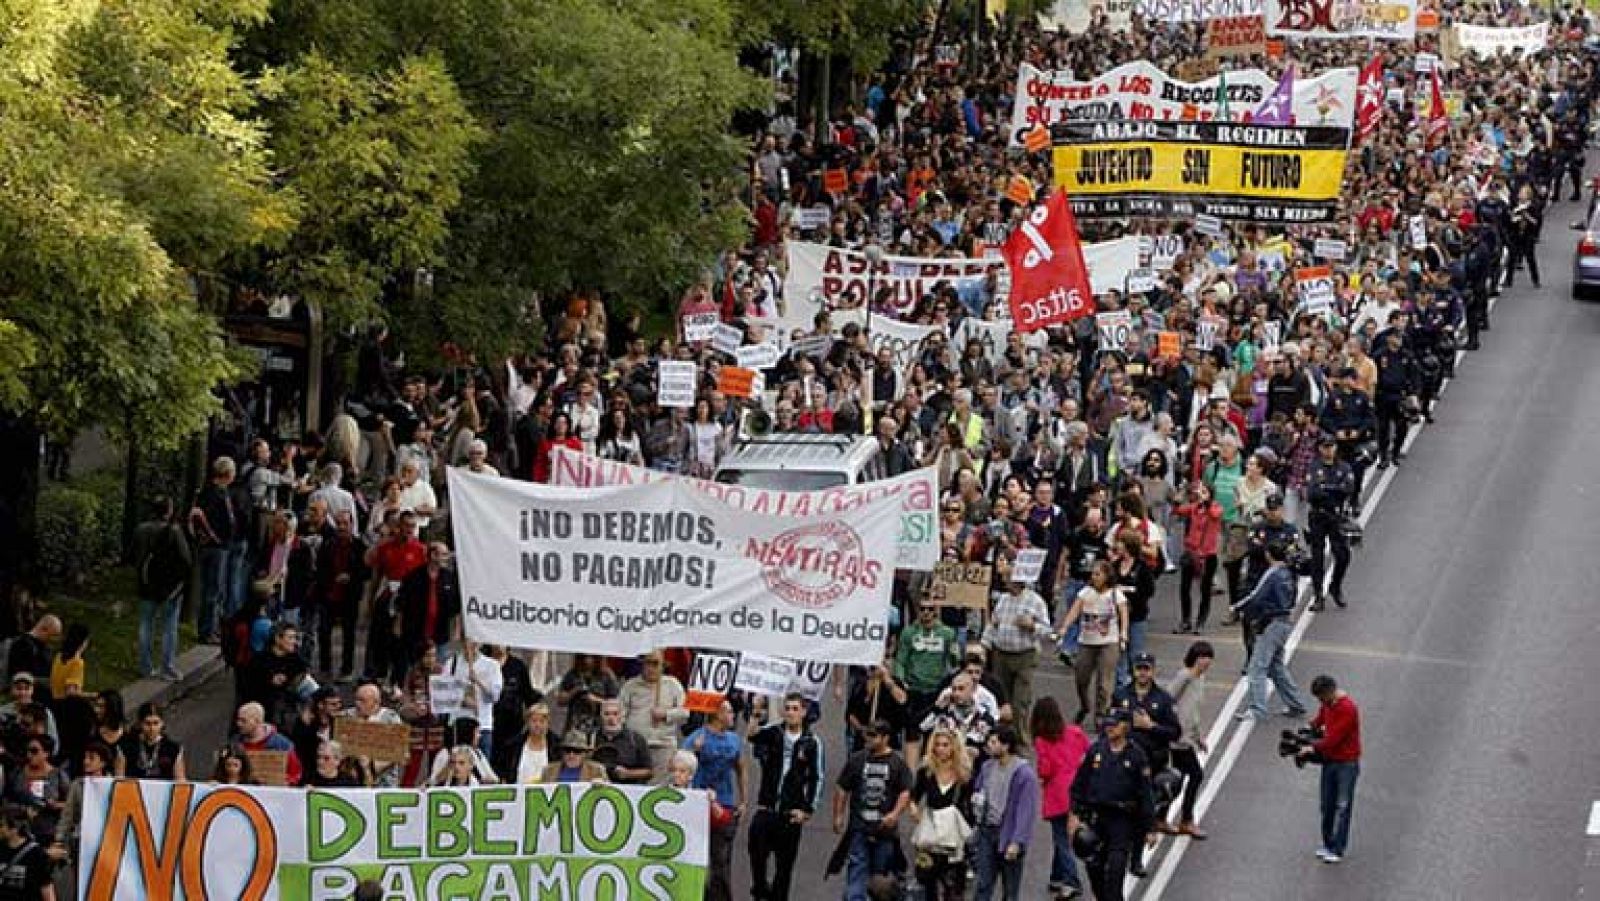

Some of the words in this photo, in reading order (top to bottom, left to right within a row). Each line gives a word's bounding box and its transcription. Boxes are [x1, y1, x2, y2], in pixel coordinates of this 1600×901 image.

[1119, 75, 1153, 95] LOS
[1130, 102, 1154, 120] NO
[1093, 120, 1157, 141] ABAJO
[1176, 123, 1200, 139] EL
[1181, 148, 1210, 185] SIN
[1241, 151, 1301, 188] FUTURO
[1100, 325, 1129, 350] NO
[520, 509, 572, 540] ¡NO
[583, 511, 722, 549] DEBEMOS,
[521, 552, 562, 582] NO
[572, 552, 716, 589] PAGAMOS!
[731, 607, 764, 629] de
[772, 609, 794, 632] la
[803, 614, 884, 640] Deuda
[690, 655, 732, 691] NO
[84, 779, 278, 901] NO
[307, 784, 686, 862] DEBEMOS
